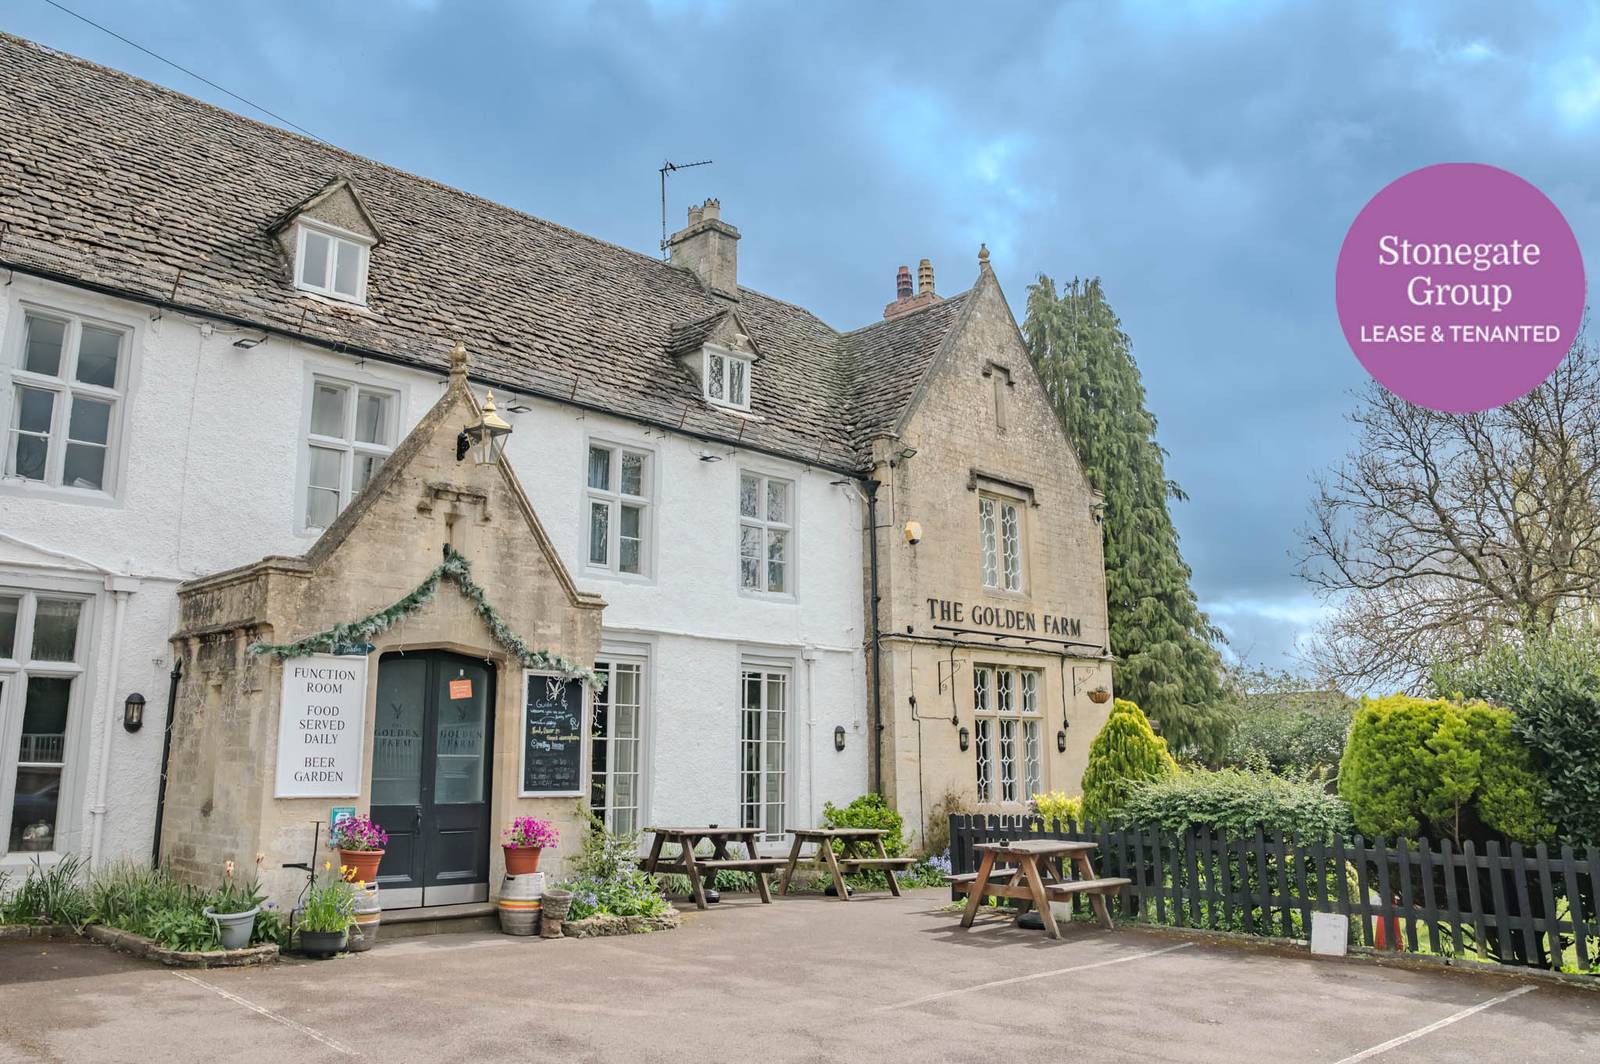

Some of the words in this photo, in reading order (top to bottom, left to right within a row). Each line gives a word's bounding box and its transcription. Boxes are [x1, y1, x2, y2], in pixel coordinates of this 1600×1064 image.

[926, 598, 964, 622] THE
[971, 605, 1036, 632] GOLDEN
[1044, 614, 1081, 637] FARM
[294, 667, 356, 681] FUNCTION
[306, 683, 342, 694] ROOM
[307, 705, 340, 717] FOOD
[299, 720, 345, 731] SERVED
[304, 733, 339, 745] DAILY
[304, 757, 336, 768] BEER
[294, 771, 344, 783] GARDEN
